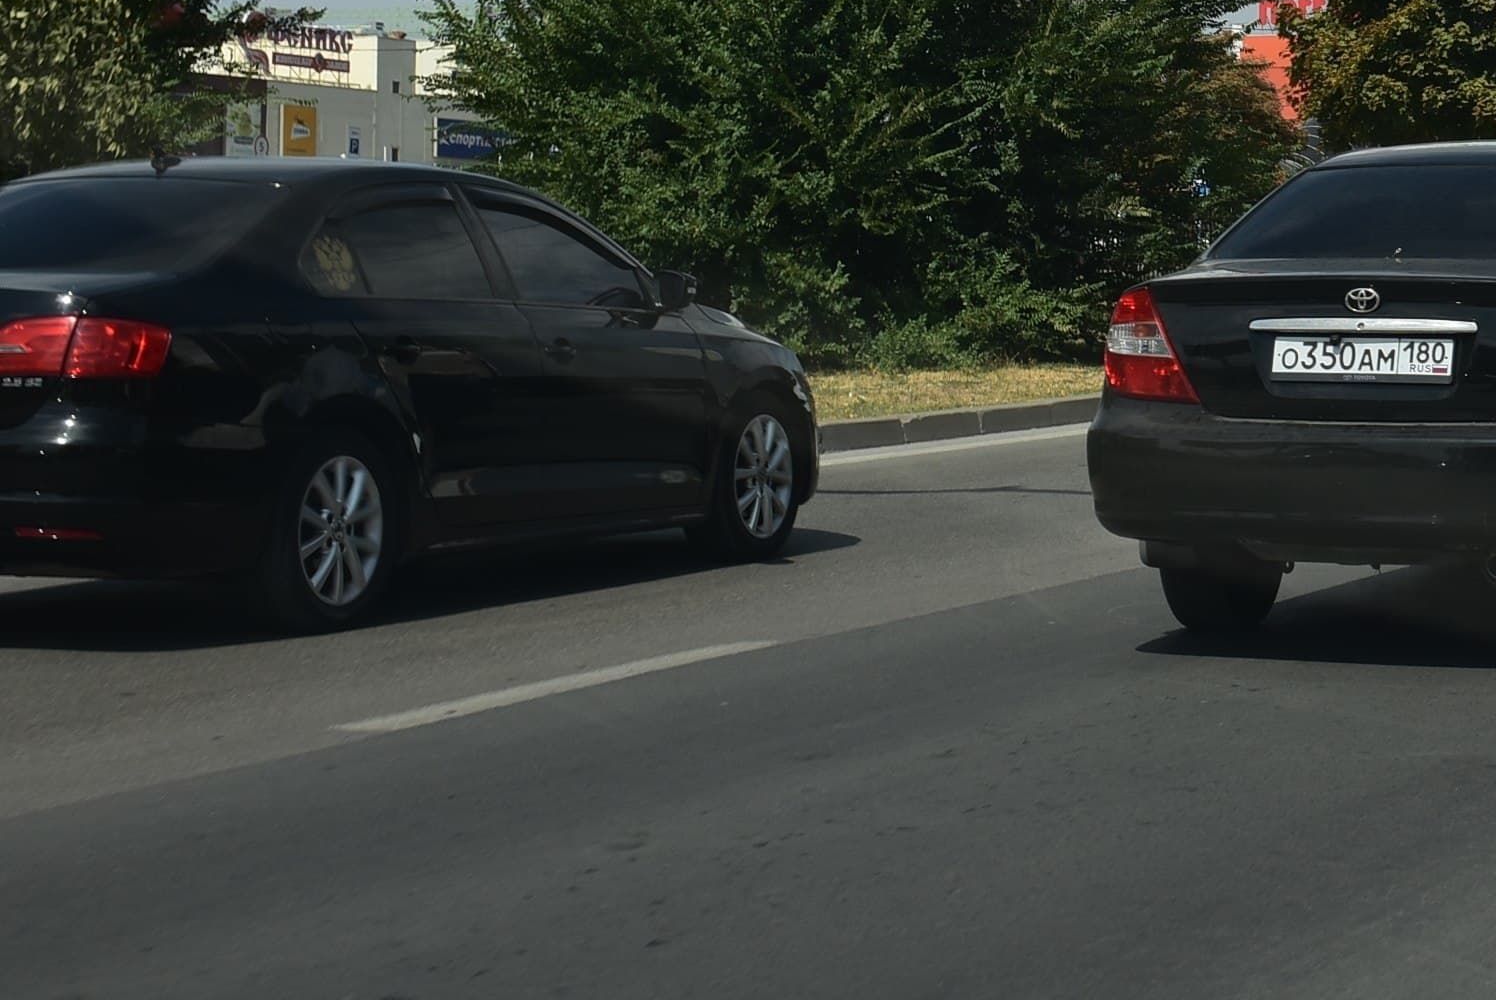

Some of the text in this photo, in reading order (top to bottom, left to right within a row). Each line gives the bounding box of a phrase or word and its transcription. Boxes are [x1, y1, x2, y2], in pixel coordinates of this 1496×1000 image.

[1281, 340, 1396, 371] О350АМ
[1403, 341, 1446, 364] 180
[1409, 364, 1432, 373] RUS
